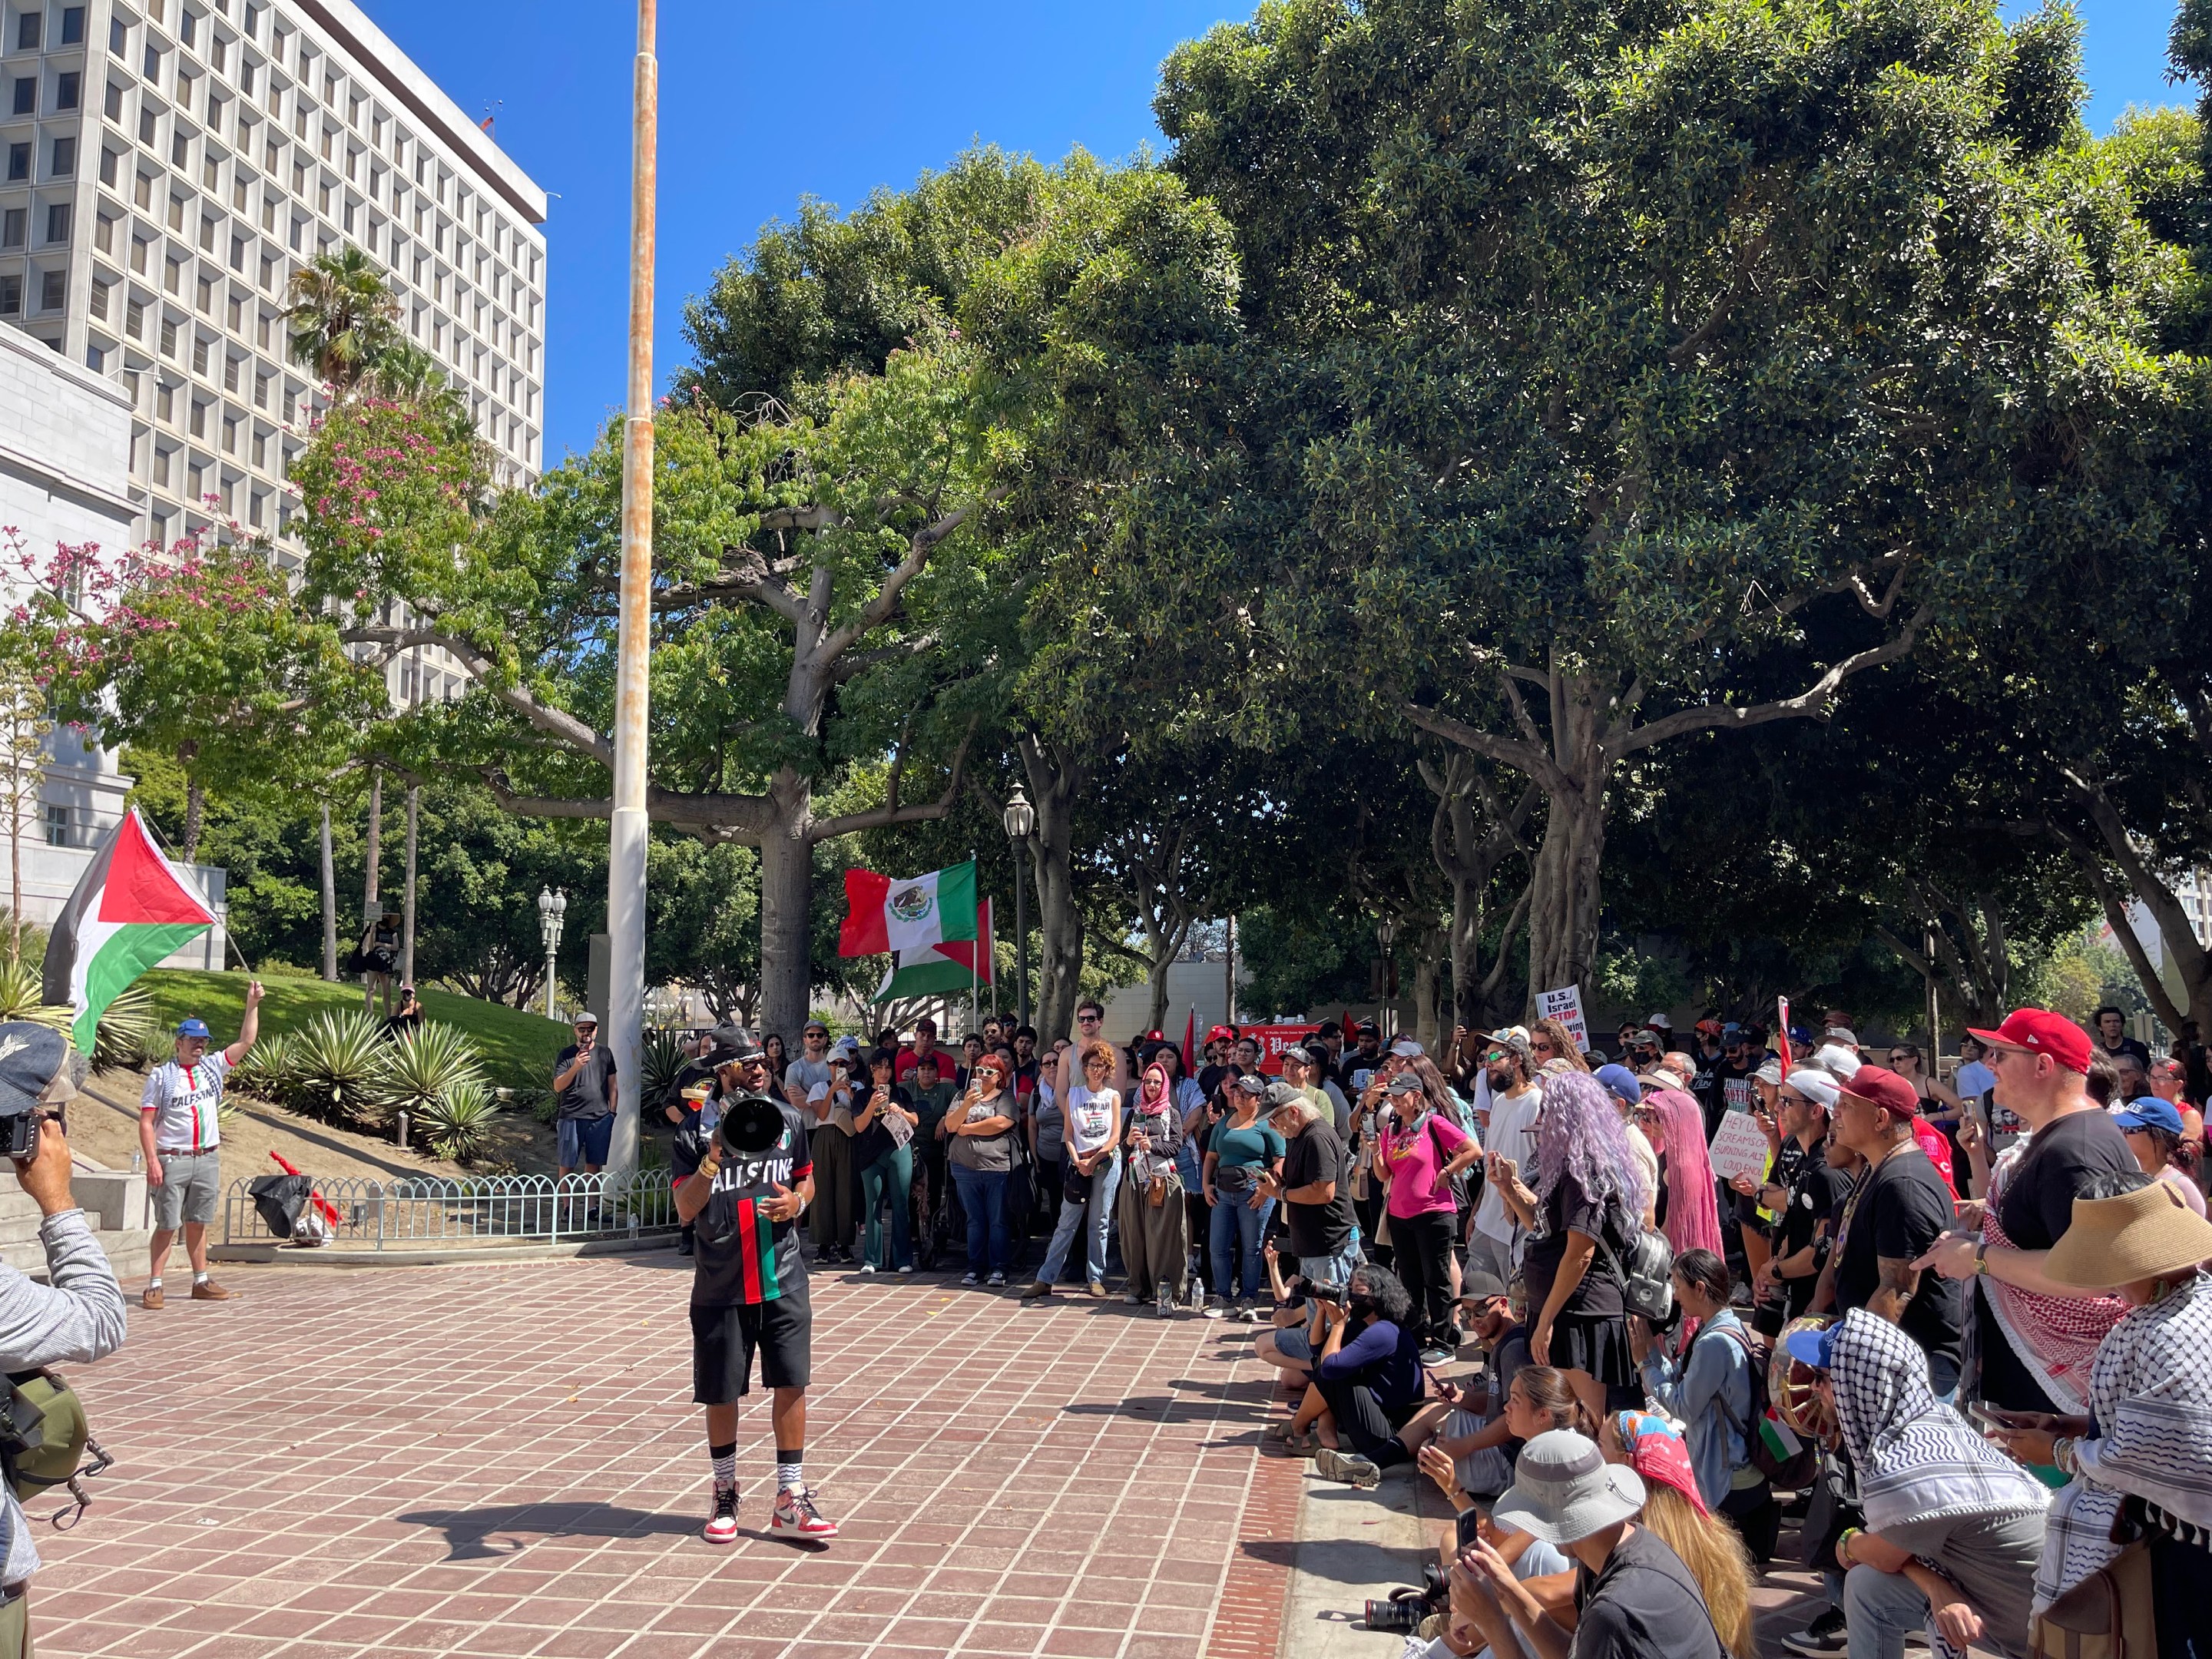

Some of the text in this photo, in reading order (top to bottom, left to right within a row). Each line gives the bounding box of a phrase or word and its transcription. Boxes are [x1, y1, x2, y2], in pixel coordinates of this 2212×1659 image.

[1547, 990, 1572, 1003] U.S./
[1547, 999, 1576, 1013] Israel
[1549, 1009, 1578, 1022] STOP
[1083, 1101, 1110, 1111] UMMAH
[1724, 1115, 1745, 1130] HEY
[1717, 1131, 1757, 1147] SCREAMS
[1714, 1144, 1748, 1157] BURNING
[1723, 1160, 1743, 1172] LOUD
